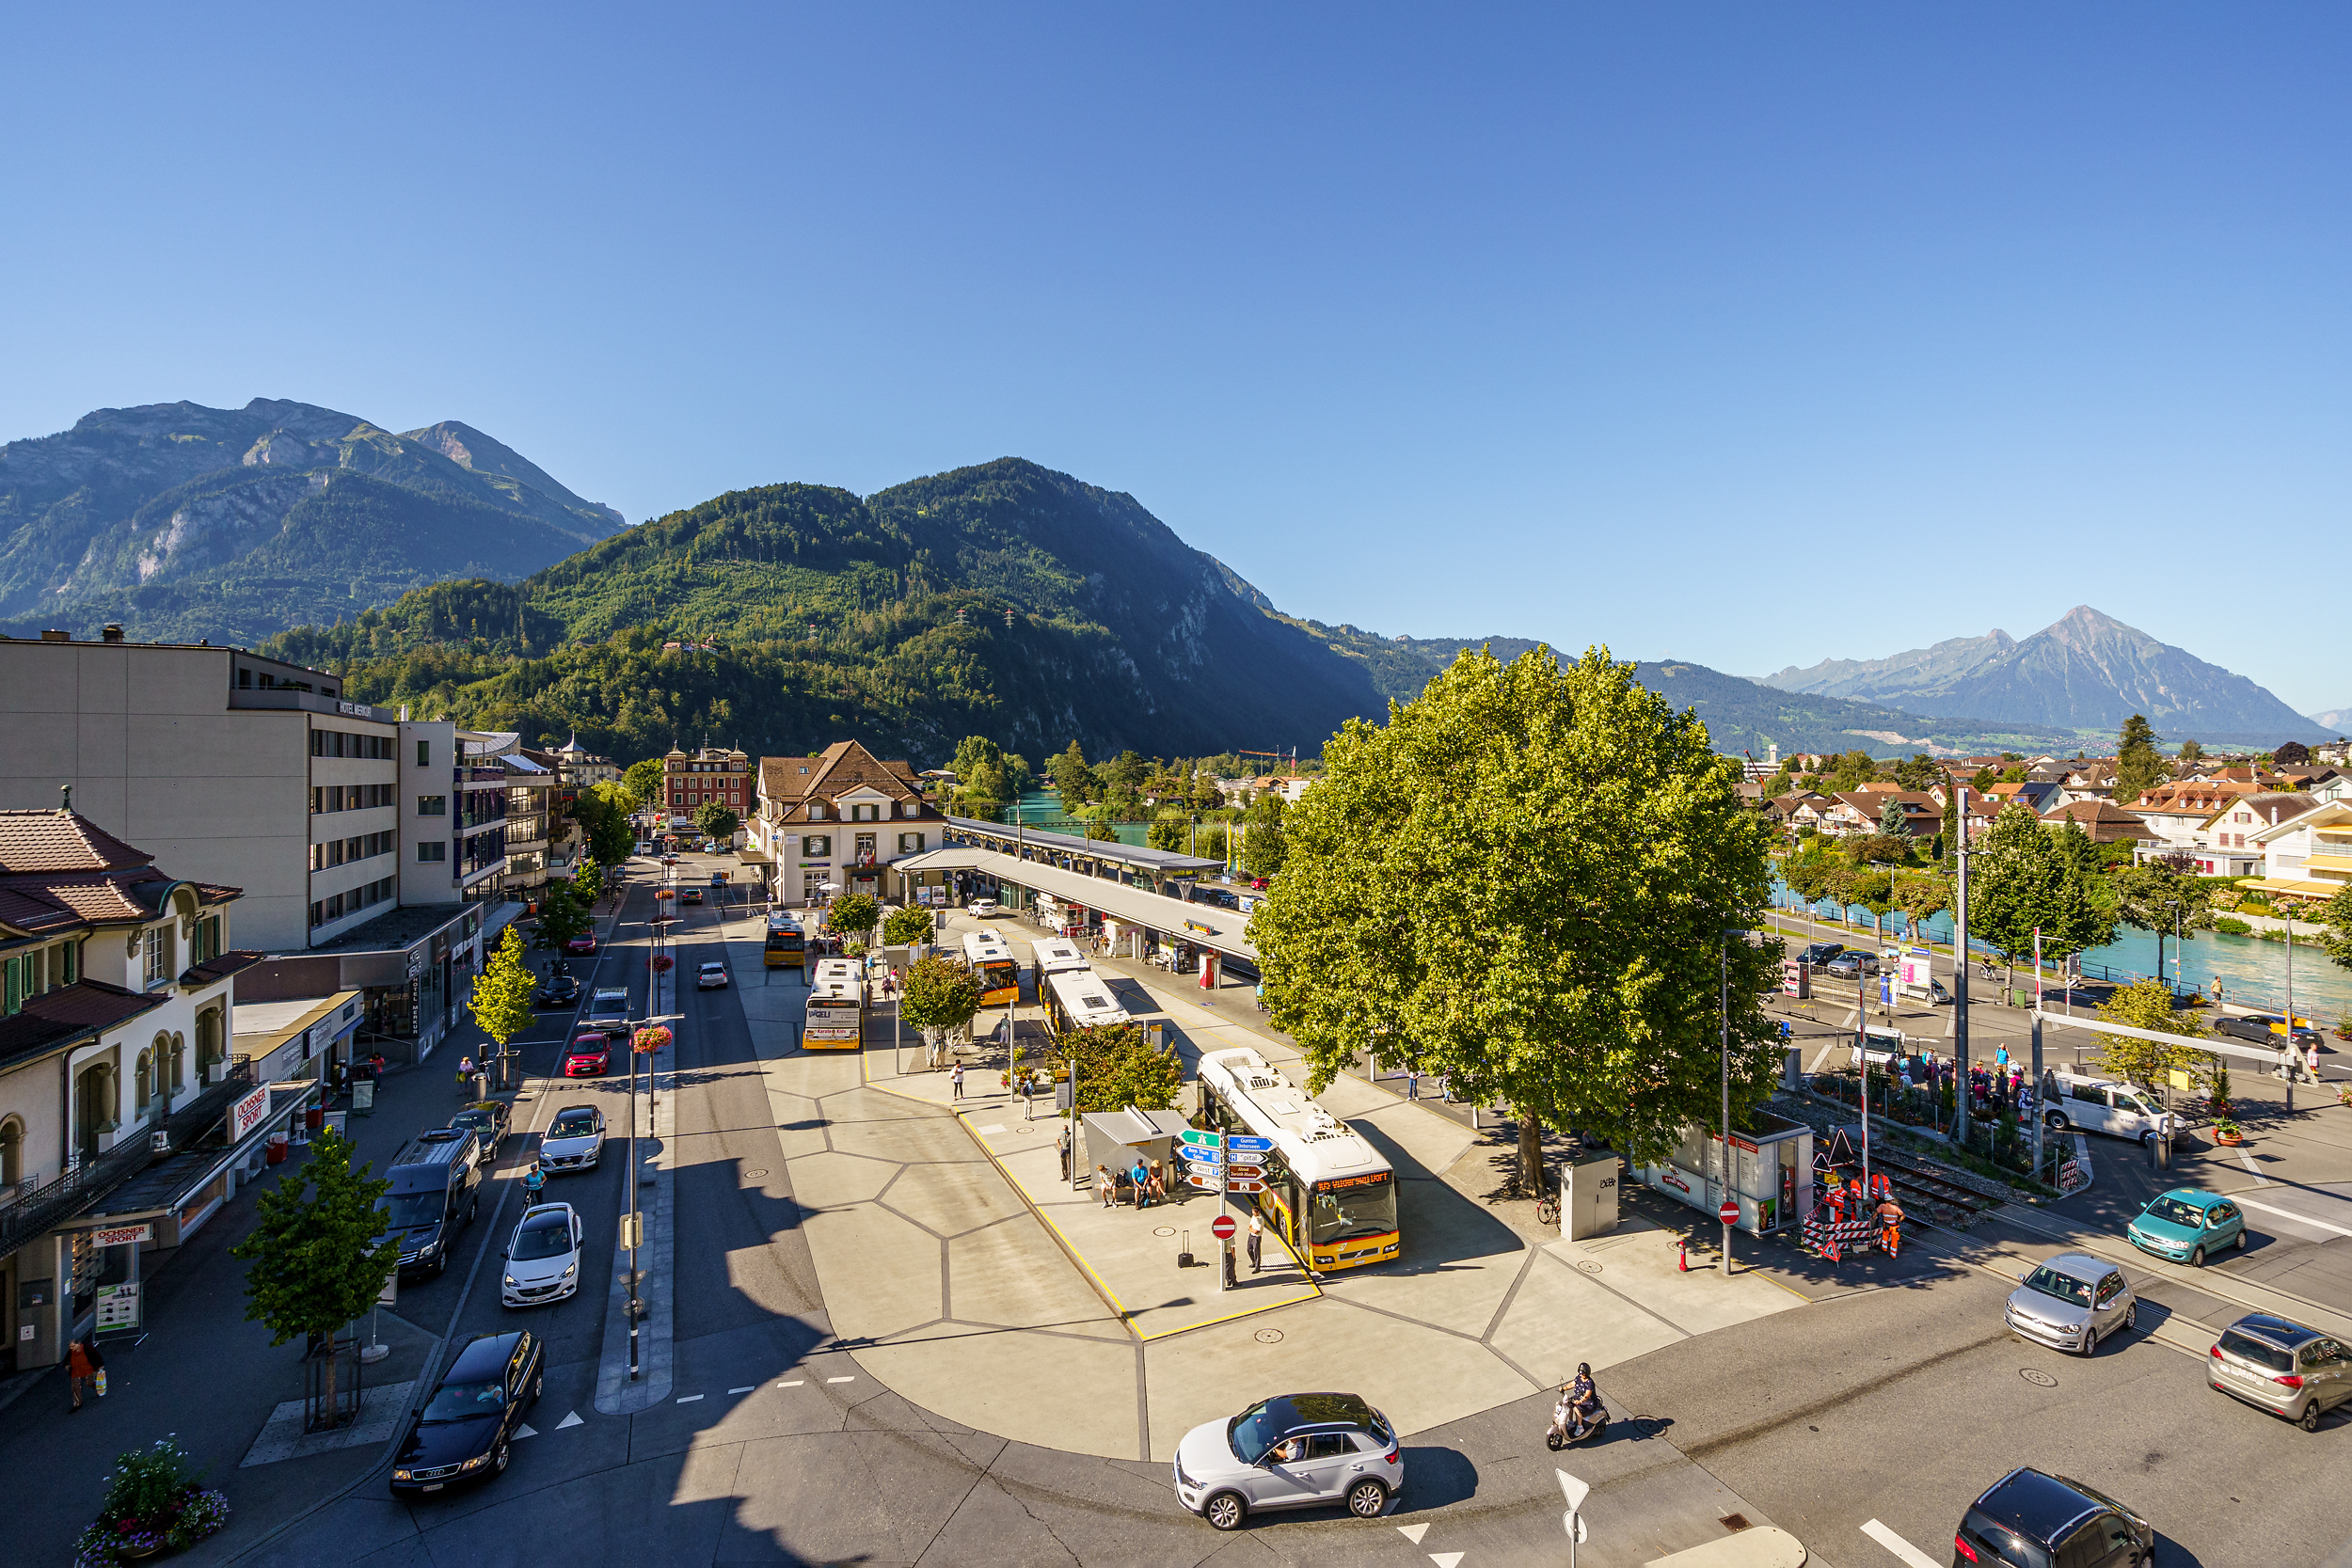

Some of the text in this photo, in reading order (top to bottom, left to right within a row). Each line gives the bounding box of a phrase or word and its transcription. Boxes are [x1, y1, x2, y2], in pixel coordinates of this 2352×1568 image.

[340, 701, 372, 718] HOTEL MERKUR
[238, 1087, 265, 1117] OCHSNER
[242, 1104, 262, 1131] SPORT
[1240, 1154, 1258, 1163] Spital
[1196, 1164, 1211, 1173] West
[97, 1226, 145, 1238] OCHSNER
[104, 1234, 138, 1244] SPORT
